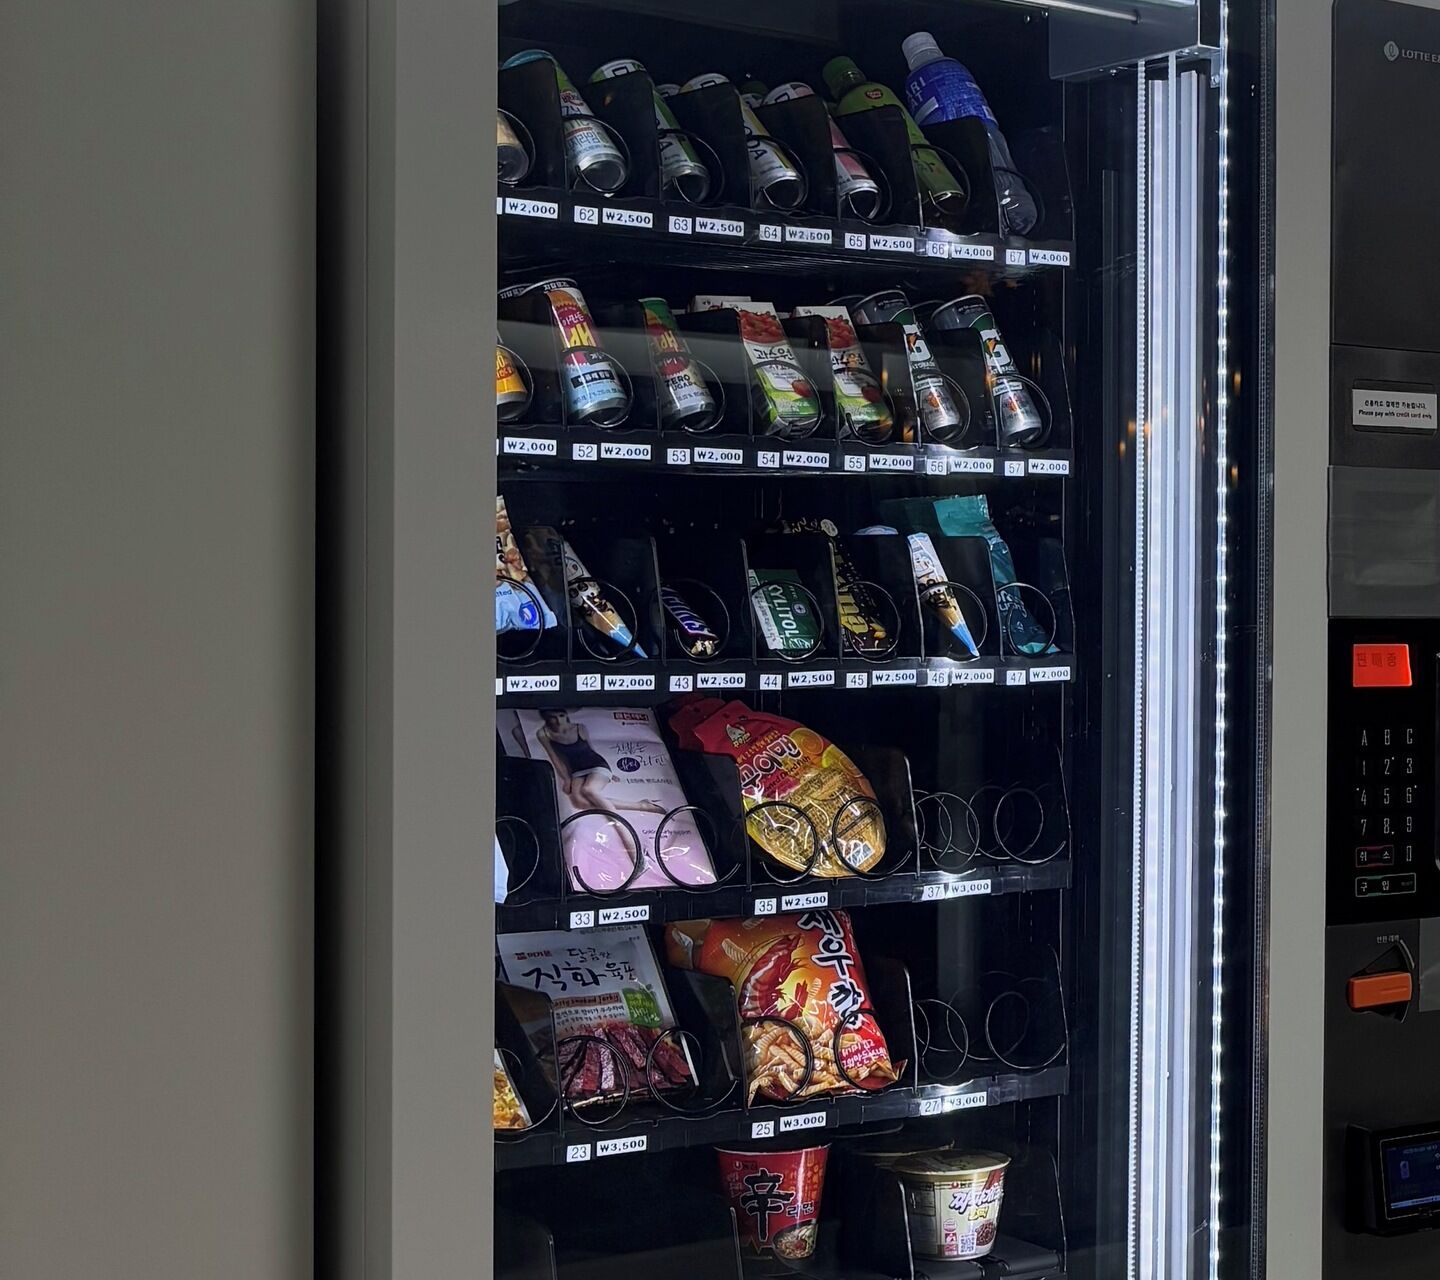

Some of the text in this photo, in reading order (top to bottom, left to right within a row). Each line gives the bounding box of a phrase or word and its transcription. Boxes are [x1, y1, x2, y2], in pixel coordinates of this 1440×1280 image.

[1402, 49, 1431, 62] LOTTE
[578, 208, 595, 222] 62
[673, 217, 689, 232] 63
[763, 226, 778, 240] 64
[848, 234, 863, 248] 65
[931, 242, 945, 256] 66
[1009, 250, 1023, 263] 67
[753, 347, 796, 361] 과수원
[577, 445, 594, 459] 52
[671, 449, 687, 463] 53
[761, 452, 776, 466] 54
[848, 456, 863, 470] 55
[930, 460, 944, 473] 56
[1008, 462, 1023, 475] 57
[581, 675, 597, 689] 42
[674, 676, 690, 690] 43
[763, 675, 778, 688] 44
[850, 674, 865, 687] 45
[931, 672, 945, 685] 46
[1010, 672, 1023, 684] 47
[1361, 730, 1368, 746] A
[1384, 729, 1391, 745] B
[1406, 728, 1413, 744] C
[1362, 760, 1366, 775] 1
[1384, 759, 1390, 775] 2
[1406, 758, 1413, 774] 3
[1360, 789, 1367, 806] 4
[1383, 788, 1390, 804] 5
[1406, 787, 1412, 803] 6
[1361, 819, 1367, 836] 7
[1383, 818, 1390, 834] 8
[1406, 816, 1412, 832] 9
[927, 885, 942, 899] 37
[758, 899, 774, 913] 35
[574, 912, 591, 926] 33
[522, 960, 636, 990] 직화 육포
[923, 1100, 939, 1113] 27
[755, 1123, 771, 1136] 25
[571, 1146, 587, 1160] 23
[740, 1168, 795, 1242] 辛
[786, 1201, 815, 1218] 라면
